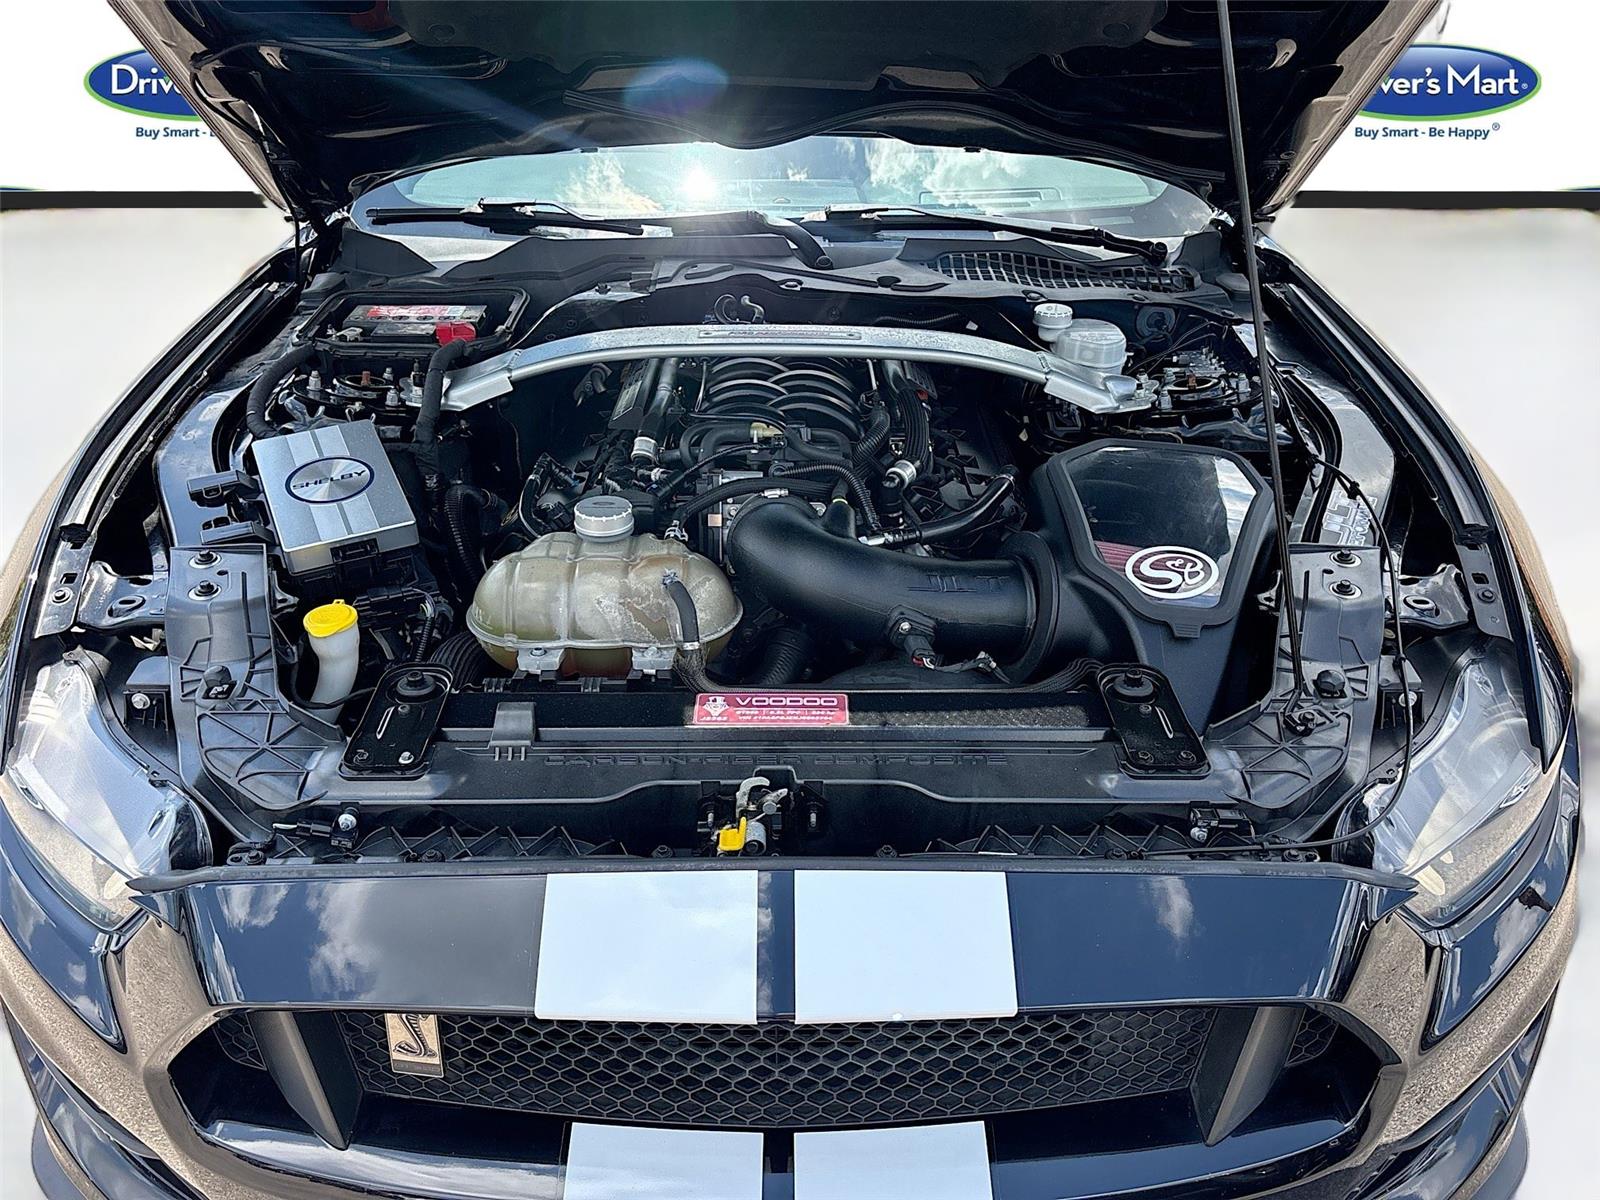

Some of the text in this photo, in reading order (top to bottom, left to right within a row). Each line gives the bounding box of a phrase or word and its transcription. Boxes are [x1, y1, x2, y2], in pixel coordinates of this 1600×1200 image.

[1376, 67, 1441, 94] ver's
[135, 127, 160, 140] Buy
[163, 127, 200, 137] Smart
[1355, 127, 1379, 140] Buy
[1382, 127, 1419, 138] Smart
[1429, 127, 1445, 138] Be
[292, 469, 367, 490] SHELBY
[736, 697, 838, 706] VOODOO
